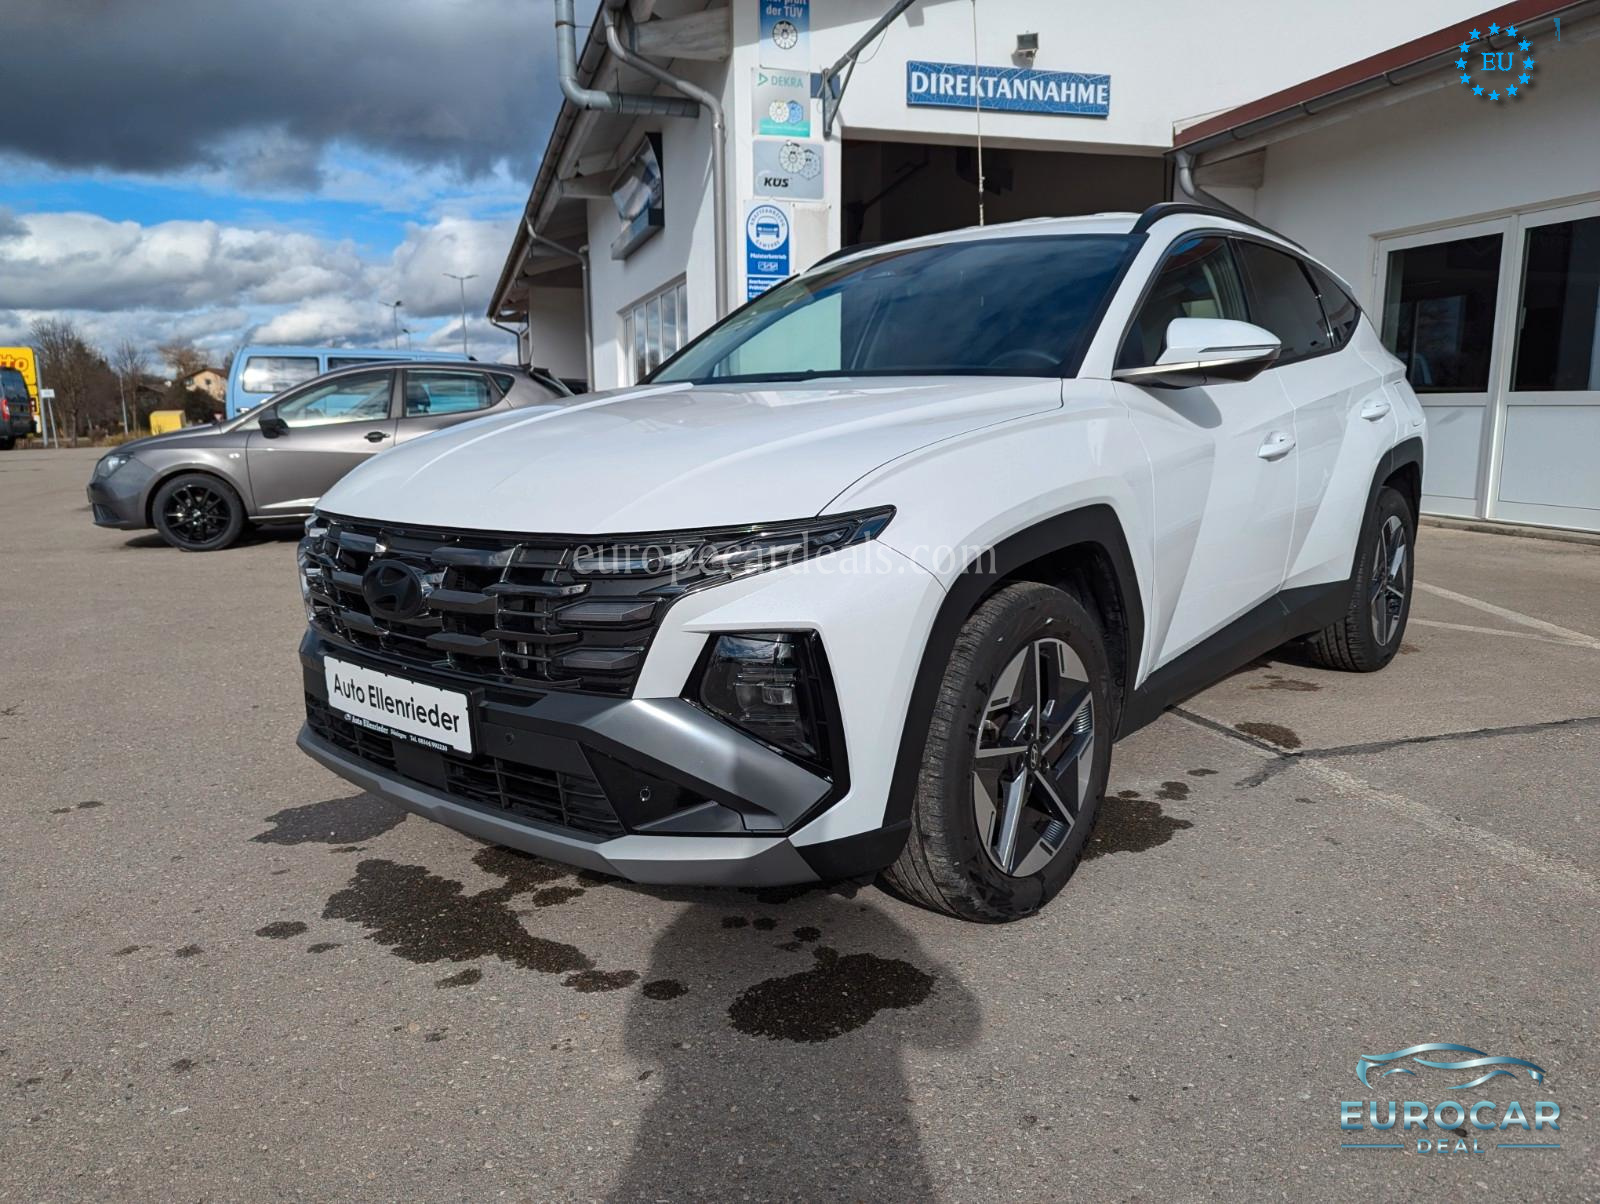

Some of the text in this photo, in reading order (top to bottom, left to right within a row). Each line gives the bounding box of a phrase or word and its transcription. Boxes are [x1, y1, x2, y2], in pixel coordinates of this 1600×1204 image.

[783, 4, 803, 18] TÜV
[770, 75, 804, 88] DEKRA
[910, 71, 1109, 105] DIREKTANNAHME
[334, 673, 460, 733] Auto Ellenrieder
